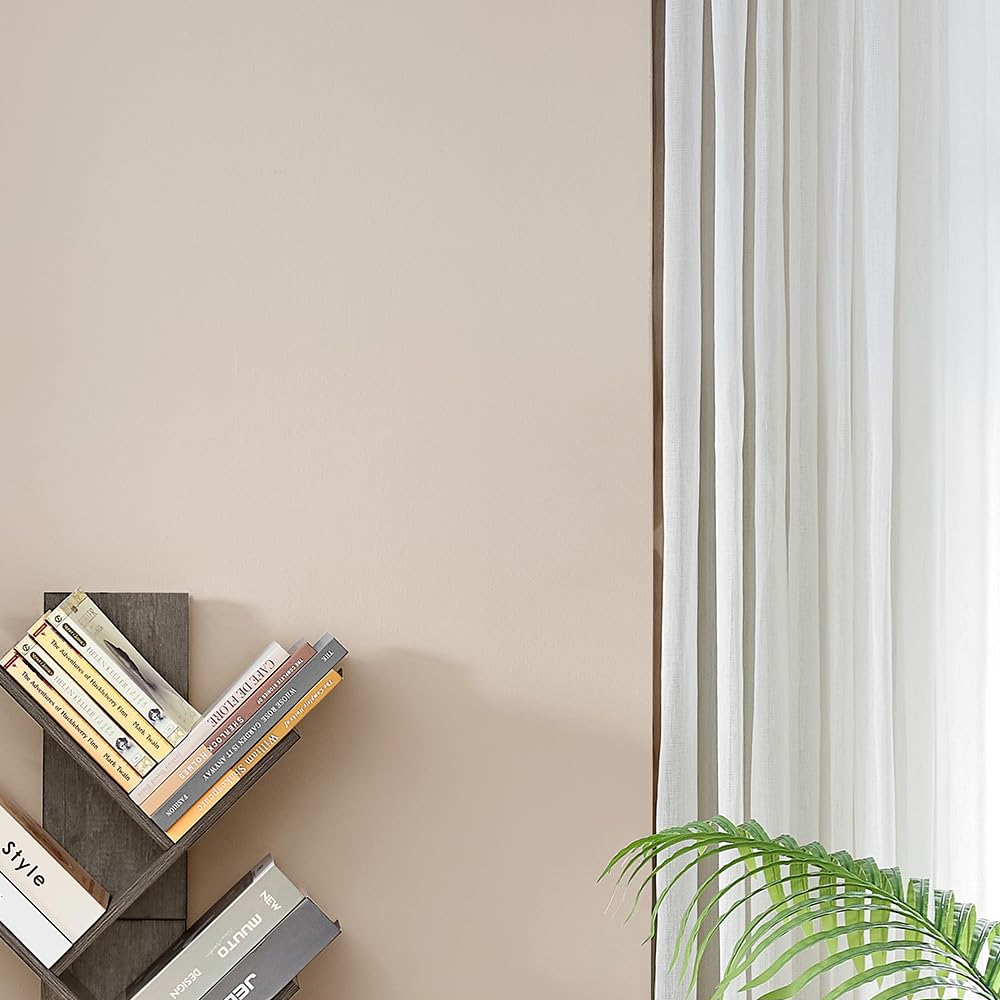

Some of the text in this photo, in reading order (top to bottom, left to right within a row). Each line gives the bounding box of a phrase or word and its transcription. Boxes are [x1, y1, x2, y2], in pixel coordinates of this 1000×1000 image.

[294, 658, 303, 667] THE
[321, 650, 334, 662] THE
[50, 639, 60, 649] The
[59, 649, 84, 674] Adventures
[89, 679, 117, 707] Huckleberry
[117, 706, 128, 717] Finn
[323, 679, 333, 689] The
[207, 659, 275, 727] CAFE DE FLORE
[303, 688, 324, 708] Complete
[21, 671, 31, 681] The
[30, 680, 55, 706] Adventures
[60, 710, 88, 739] Huckleberry
[87, 737, 98, 749] Finn
[283, 719, 290, 728] of
[132, 721, 160, 749] Mark Twain
[177, 716, 244, 780] SHERLOCK HOLMES
[202, 687, 296, 781] WHOSE ROSE GARDEN IS IT ANYWAY
[103, 753, 130, 781] Mark Twain
[198, 730, 279, 810] William Shakespeare
[165, 794, 188, 816] FASHION
[2, 841, 45, 886] Style
[259, 890, 282, 911] NEW
[169, 968, 202, 999] DESIGN
